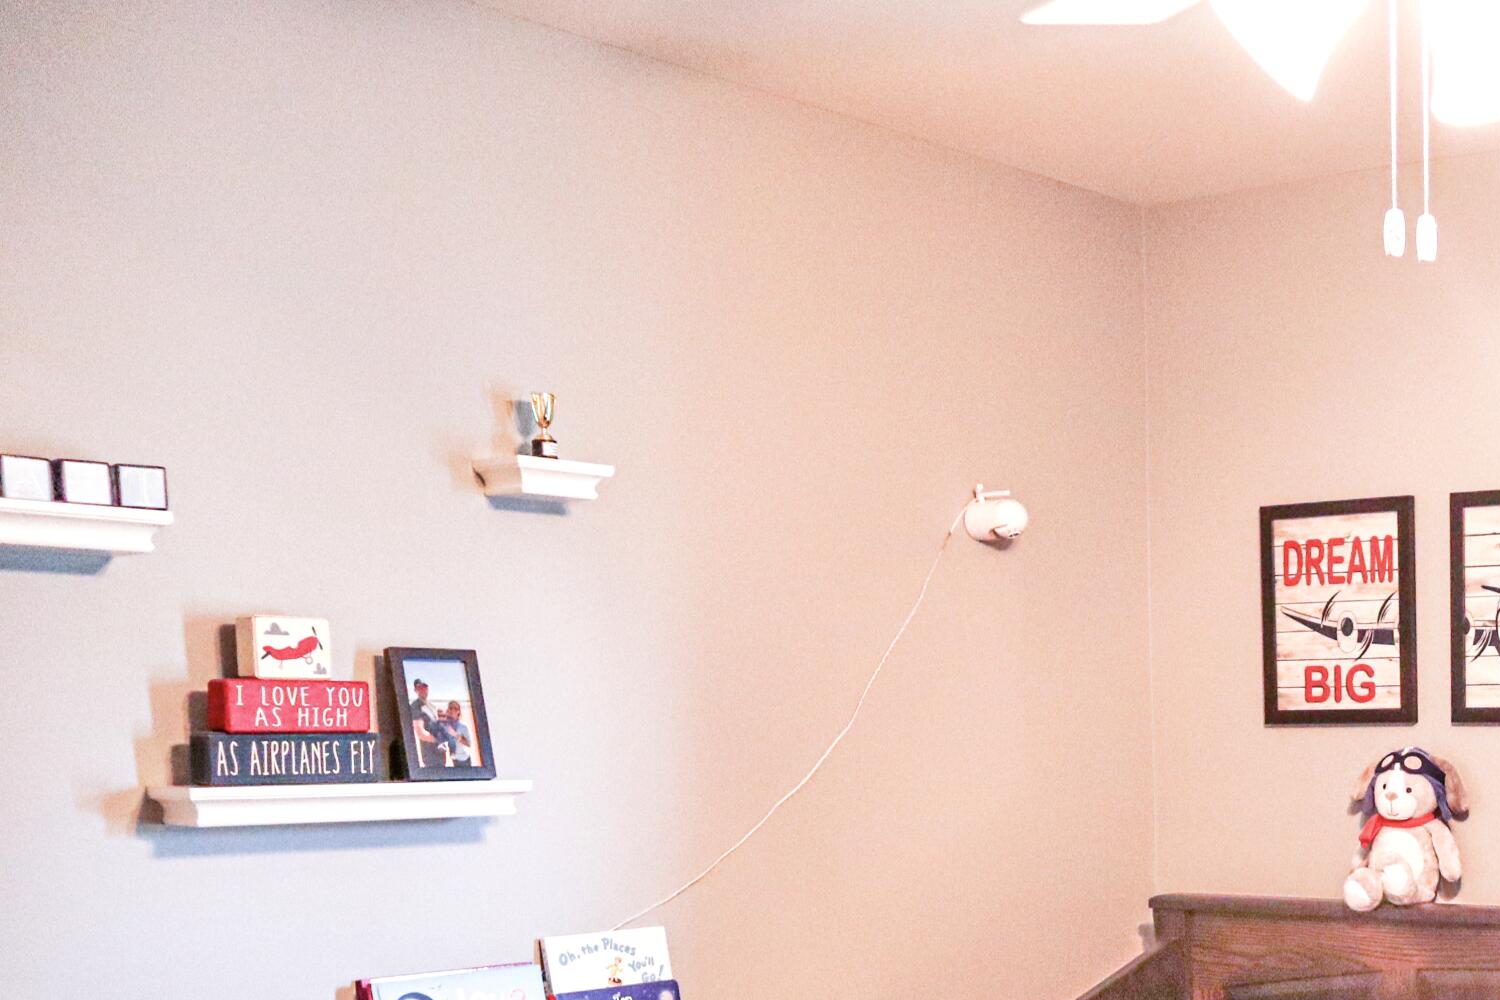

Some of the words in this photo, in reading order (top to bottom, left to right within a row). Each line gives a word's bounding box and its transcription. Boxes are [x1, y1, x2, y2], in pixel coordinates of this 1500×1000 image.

[1282, 534, 1394, 587] DREAM
[1304, 664, 1377, 704] BIG
[235, 685, 244, 707] I
[261, 686, 310, 708] LOVE
[326, 686, 364, 708] YOU
[254, 707, 282, 728] AS
[298, 707, 349, 728] HIGH
[217, 741, 240, 777] AS
[250, 740, 341, 777] AIRPLANES
[350, 740, 376, 776] FLY
[581, 943, 599, 956] the
[601, 937, 637, 957] Places
[627, 956, 655, 972] You'll
[641, 964, 664, 983] Go!
